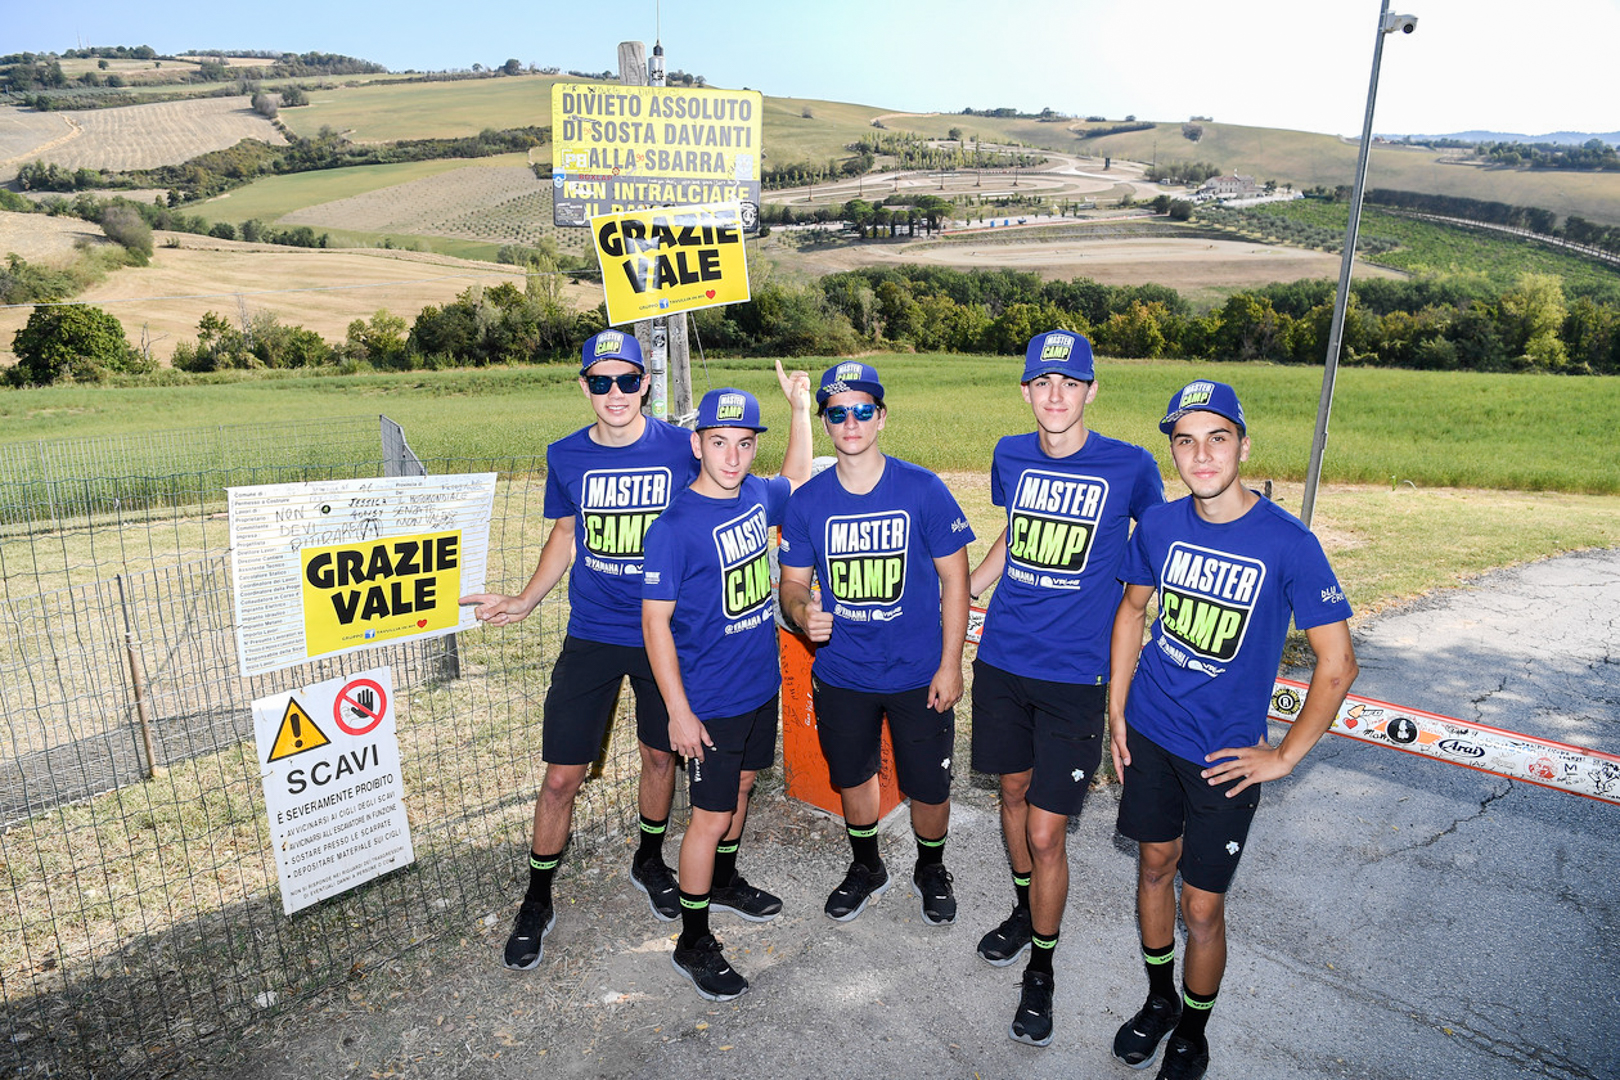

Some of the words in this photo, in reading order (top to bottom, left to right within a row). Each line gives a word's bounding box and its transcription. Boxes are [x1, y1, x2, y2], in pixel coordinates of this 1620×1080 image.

[562, 92, 641, 117] DIVIETO
[649, 95, 751, 121] ASSOLUTO
[563, 120, 583, 142] DI
[591, 120, 656, 144] SOSTA
[664, 123, 751, 148] DAVANTI
[590, 147, 636, 170] ALLA
[645, 149, 725, 173] SBARRA
[563, 180, 606, 200] NON
[614, 182, 750, 203] INTRALCIARE
[599, 210, 739, 257] GRAZIE
[623, 249, 722, 293] VALE
[596, 341, 620, 354] CAMP
[1043, 345, 1069, 358] CAMP
[718, 405, 743, 419] CAMP
[1181, 391, 1208, 407] CAMP
[587, 474, 666, 507] MASTER
[1019, 477, 1102, 518] MASTER
[831, 517, 905, 553] MASTER
[1010, 517, 1088, 565] CAMP
[306, 535, 458, 589] GRAZIE
[592, 558, 619, 572] YAMAHA
[831, 557, 902, 599] CAMP
[1167, 550, 1258, 602] MASTER
[331, 577, 436, 625] VALE
[1163, 592, 1241, 653] CAMP
[1448, 742, 1480, 755] Arai
[286, 744, 379, 795] SCAVI
[286, 788, 353, 821] SEVERAMENTE
[355, 773, 394, 795] PROIBITO
[287, 816, 330, 837] AVVICINARSI
[339, 806, 356, 818] CIGLI
[358, 799, 376, 811] DEGLI
[378, 791, 396, 802] SCAVI
[372, 803, 396, 818] FUNZIONE
[291, 846, 321, 865] SOSTARE
[323, 836, 349, 851] PRESSO
[351, 832, 359, 841] LE
[360, 819, 391, 836] SCARPATE
[293, 855, 335, 878] DEPOSITARE
[337, 842, 372, 860] MATERIALE
